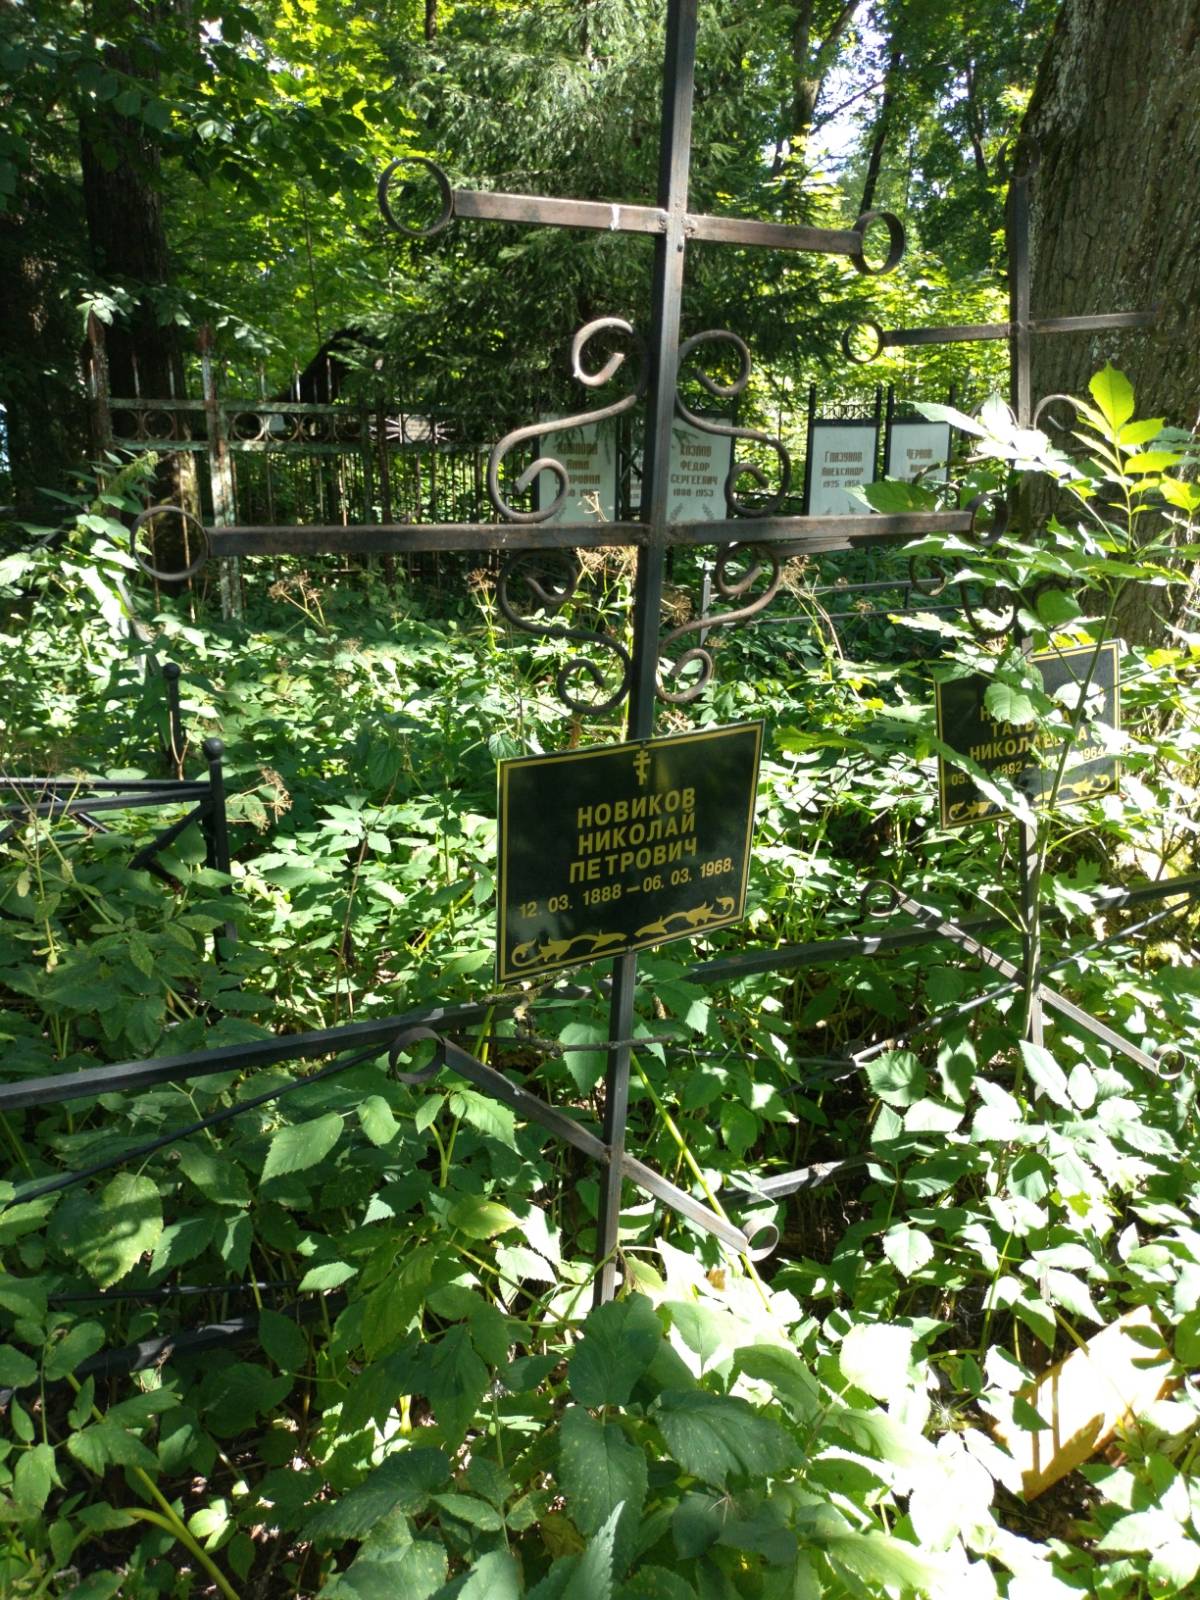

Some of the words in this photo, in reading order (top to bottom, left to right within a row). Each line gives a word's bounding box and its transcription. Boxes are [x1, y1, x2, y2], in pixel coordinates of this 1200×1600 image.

[680, 460, 710, 472] ФЕДОР
[970, 726, 1088, 762] НИКОЛАЕА
[576, 787, 697, 829] НОВИКОВ
[577, 808, 696, 855] НИКОЛАЙ
[568, 836, 698, 884] ПЕТРОВИЧ
[549, 894, 574, 913] 03.
[582, 884, 622, 906] 1888
[642, 876, 665, 893] 06.
[671, 868, 692, 886] 03.
[699, 857, 735, 879] 1968.
